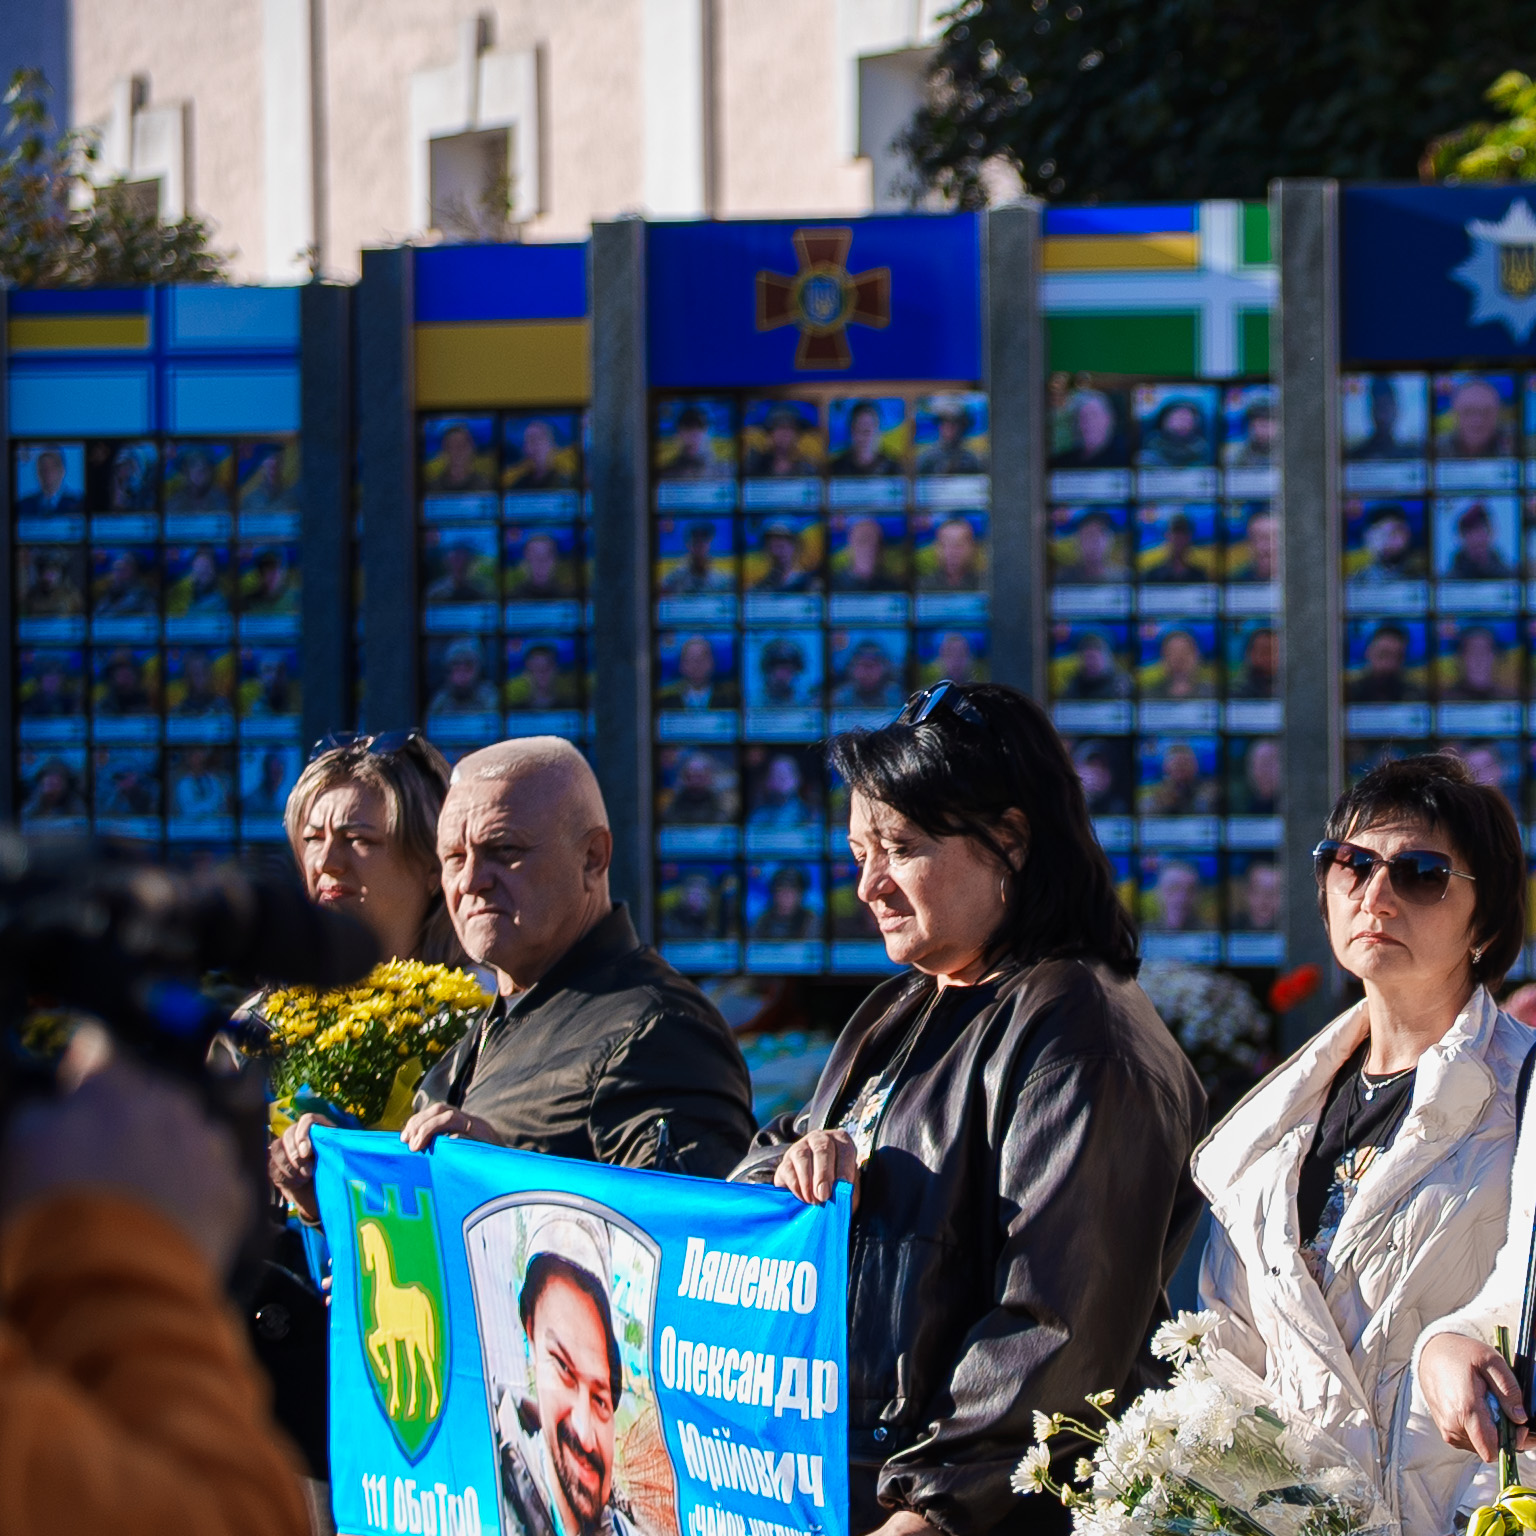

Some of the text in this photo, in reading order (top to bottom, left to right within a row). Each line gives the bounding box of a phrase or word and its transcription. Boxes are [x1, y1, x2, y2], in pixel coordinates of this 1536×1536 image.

[677, 1236, 818, 1315] Ляшенко
[660, 1325, 839, 1420] Олександр
[362, 1472, 388, 1531] 111
[677, 1419, 825, 1508] Юрійович
